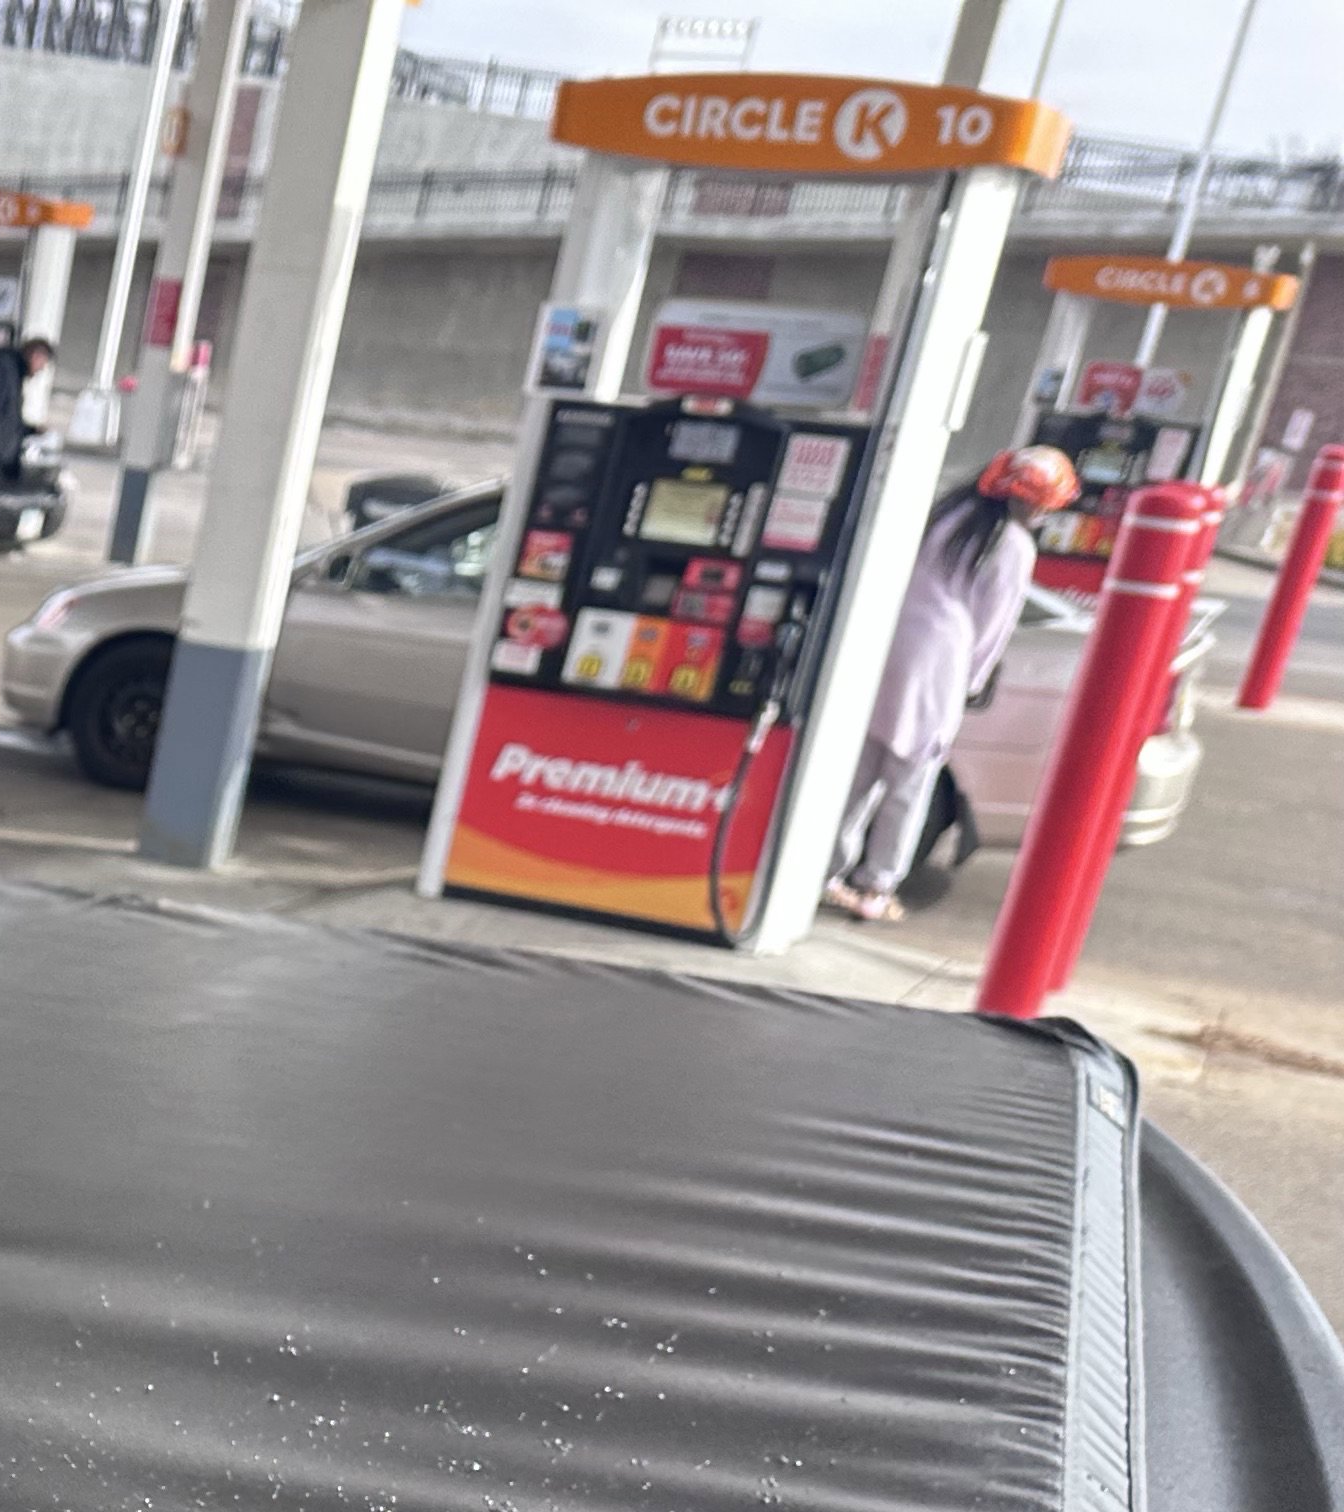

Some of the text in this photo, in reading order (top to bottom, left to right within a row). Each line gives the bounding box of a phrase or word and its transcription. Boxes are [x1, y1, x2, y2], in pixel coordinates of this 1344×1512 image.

[643, 92, 993, 158] CIRCLE K 10
